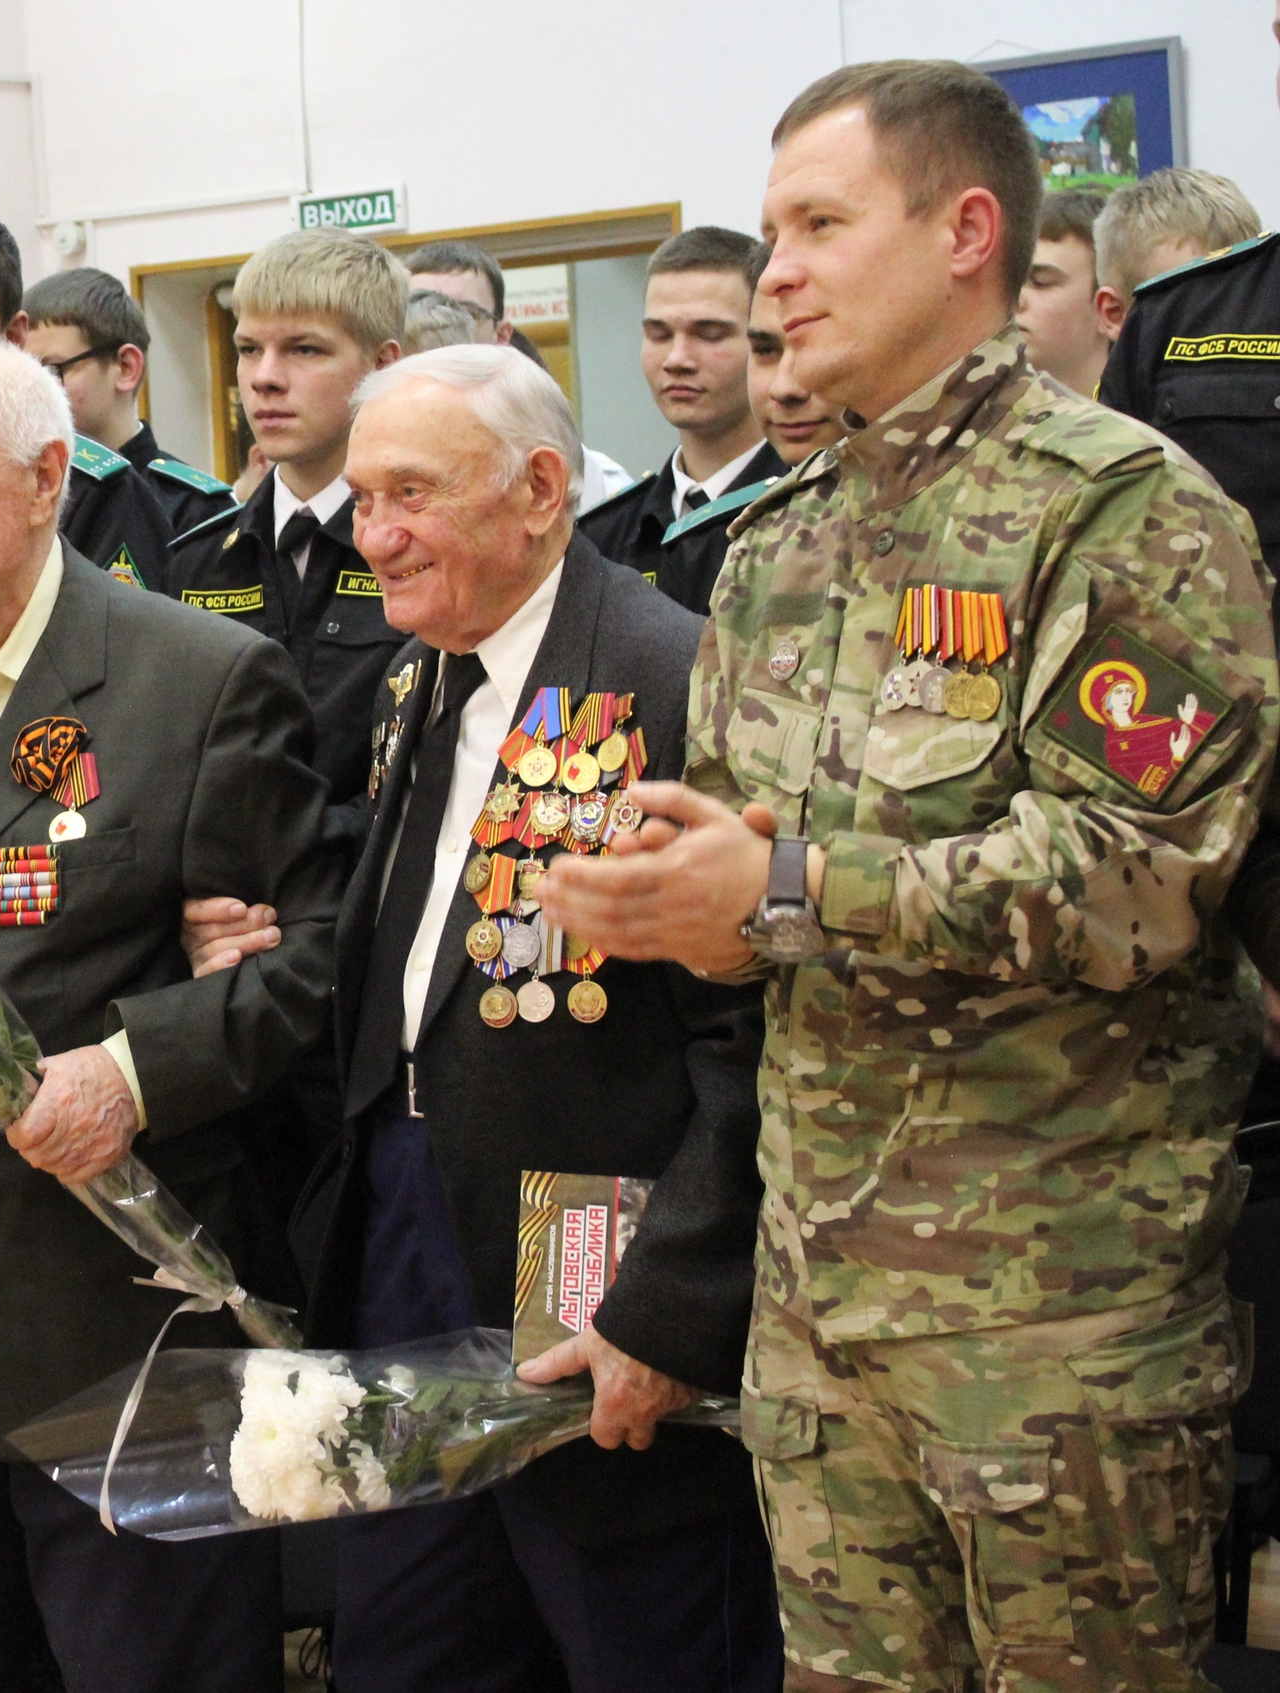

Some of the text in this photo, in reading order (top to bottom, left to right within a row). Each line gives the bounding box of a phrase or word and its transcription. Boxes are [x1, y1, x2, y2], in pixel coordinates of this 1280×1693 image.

[303, 195, 393, 229] ВЫХОД
[1174, 343, 1197, 356] ПС
[1198, 340, 1226, 355] ФСБ
[188, 591, 261, 608] ПС ФСБ РОССИИ
[347, 577, 382, 592] ИГНА
[561, 1212, 583, 1328] ЛЬГОВСКАЯ
[584, 1207, 606, 1329] ЕСПУБЛИКА
[545, 1284, 554, 1314] СЕРГЕЙ
